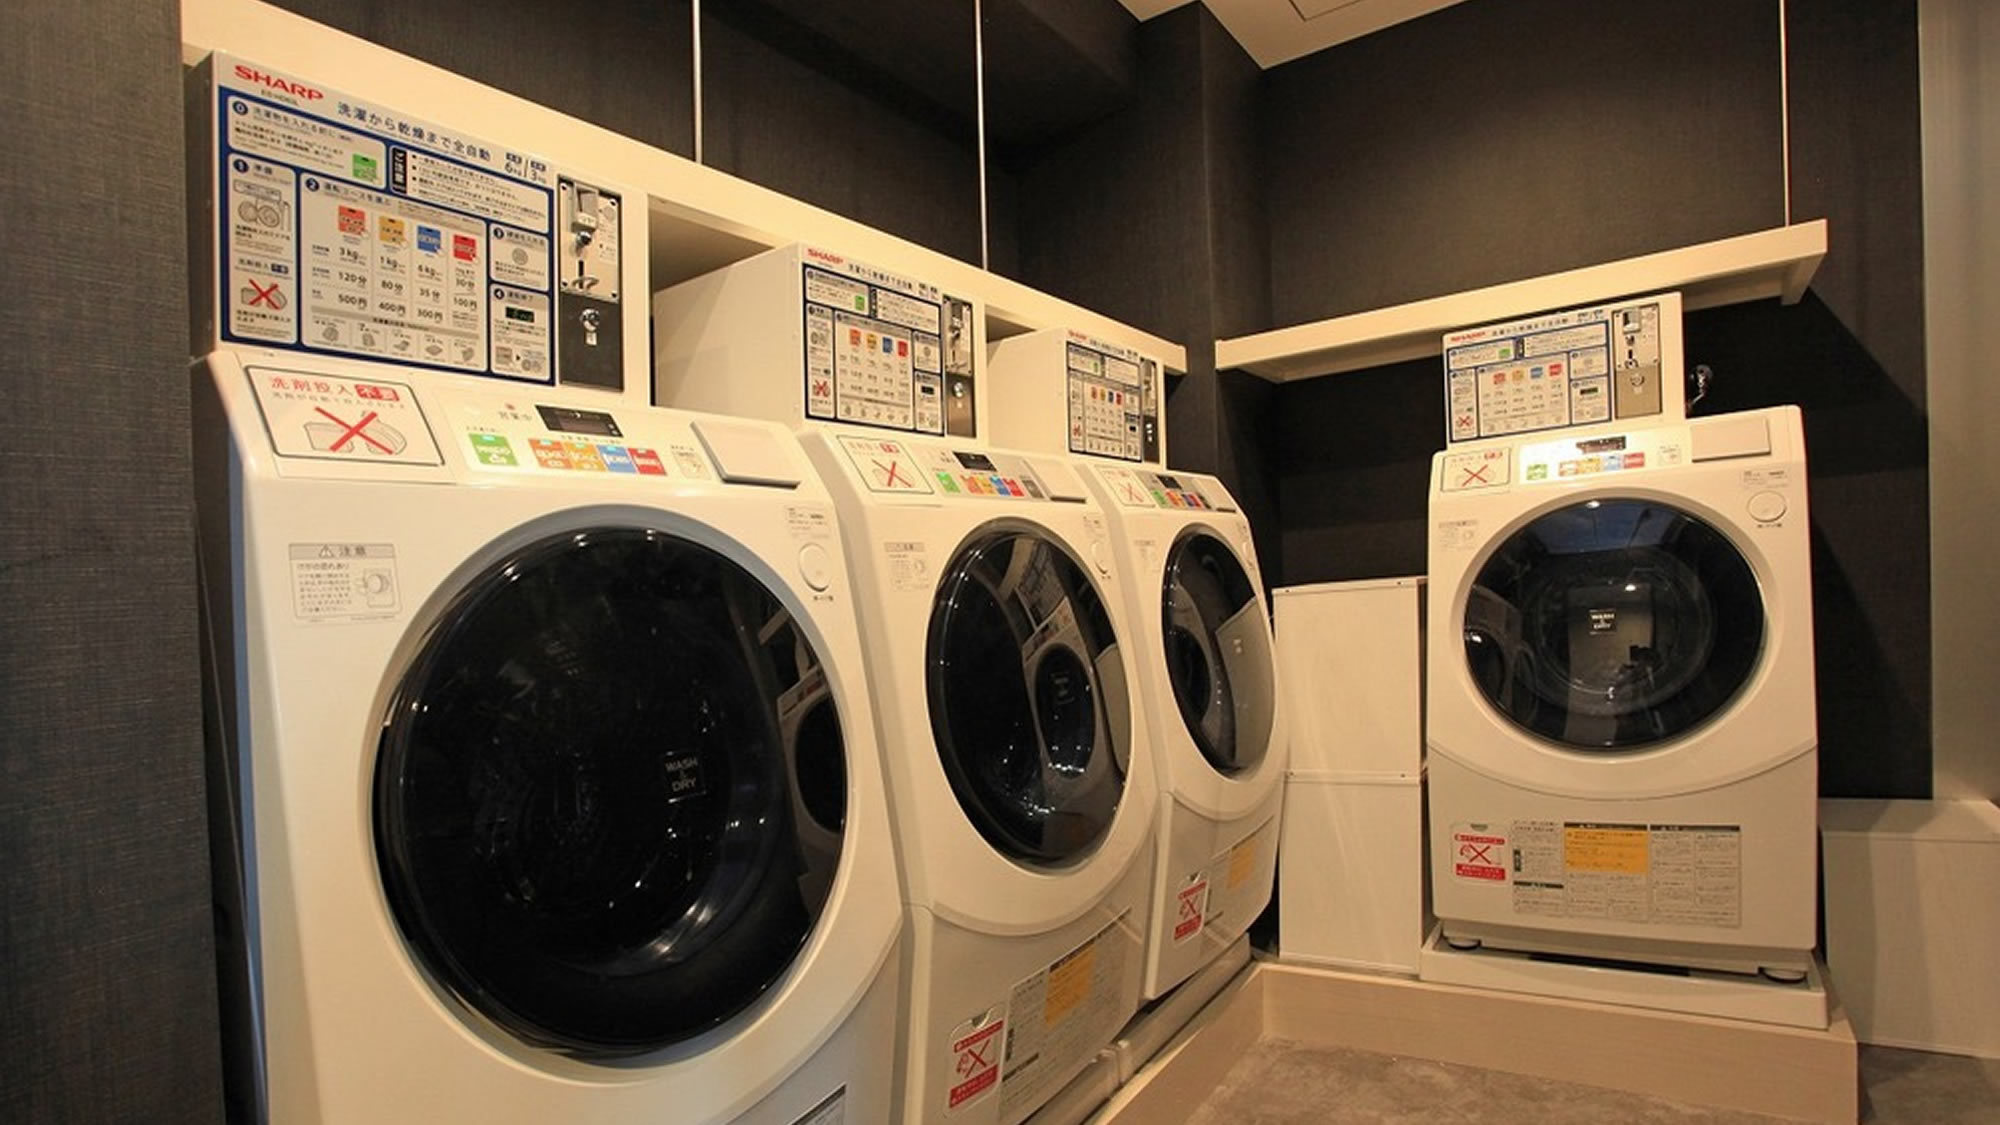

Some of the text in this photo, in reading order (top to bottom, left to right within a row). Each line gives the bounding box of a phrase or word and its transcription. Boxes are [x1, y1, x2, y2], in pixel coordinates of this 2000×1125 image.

[235, 65, 323, 101] SHARP
[338, 101, 491, 161] 洗濯から乾燥まで全自動
[338, 271, 367, 285] 120分
[381, 280, 403, 293] 80分
[338, 294, 367, 309] 500円
[270, 376, 353, 397] 洗剤投入
[339, 545, 367, 558] 注意
[665, 756, 698, 772] WASH
[672, 776, 697, 793] DRY
